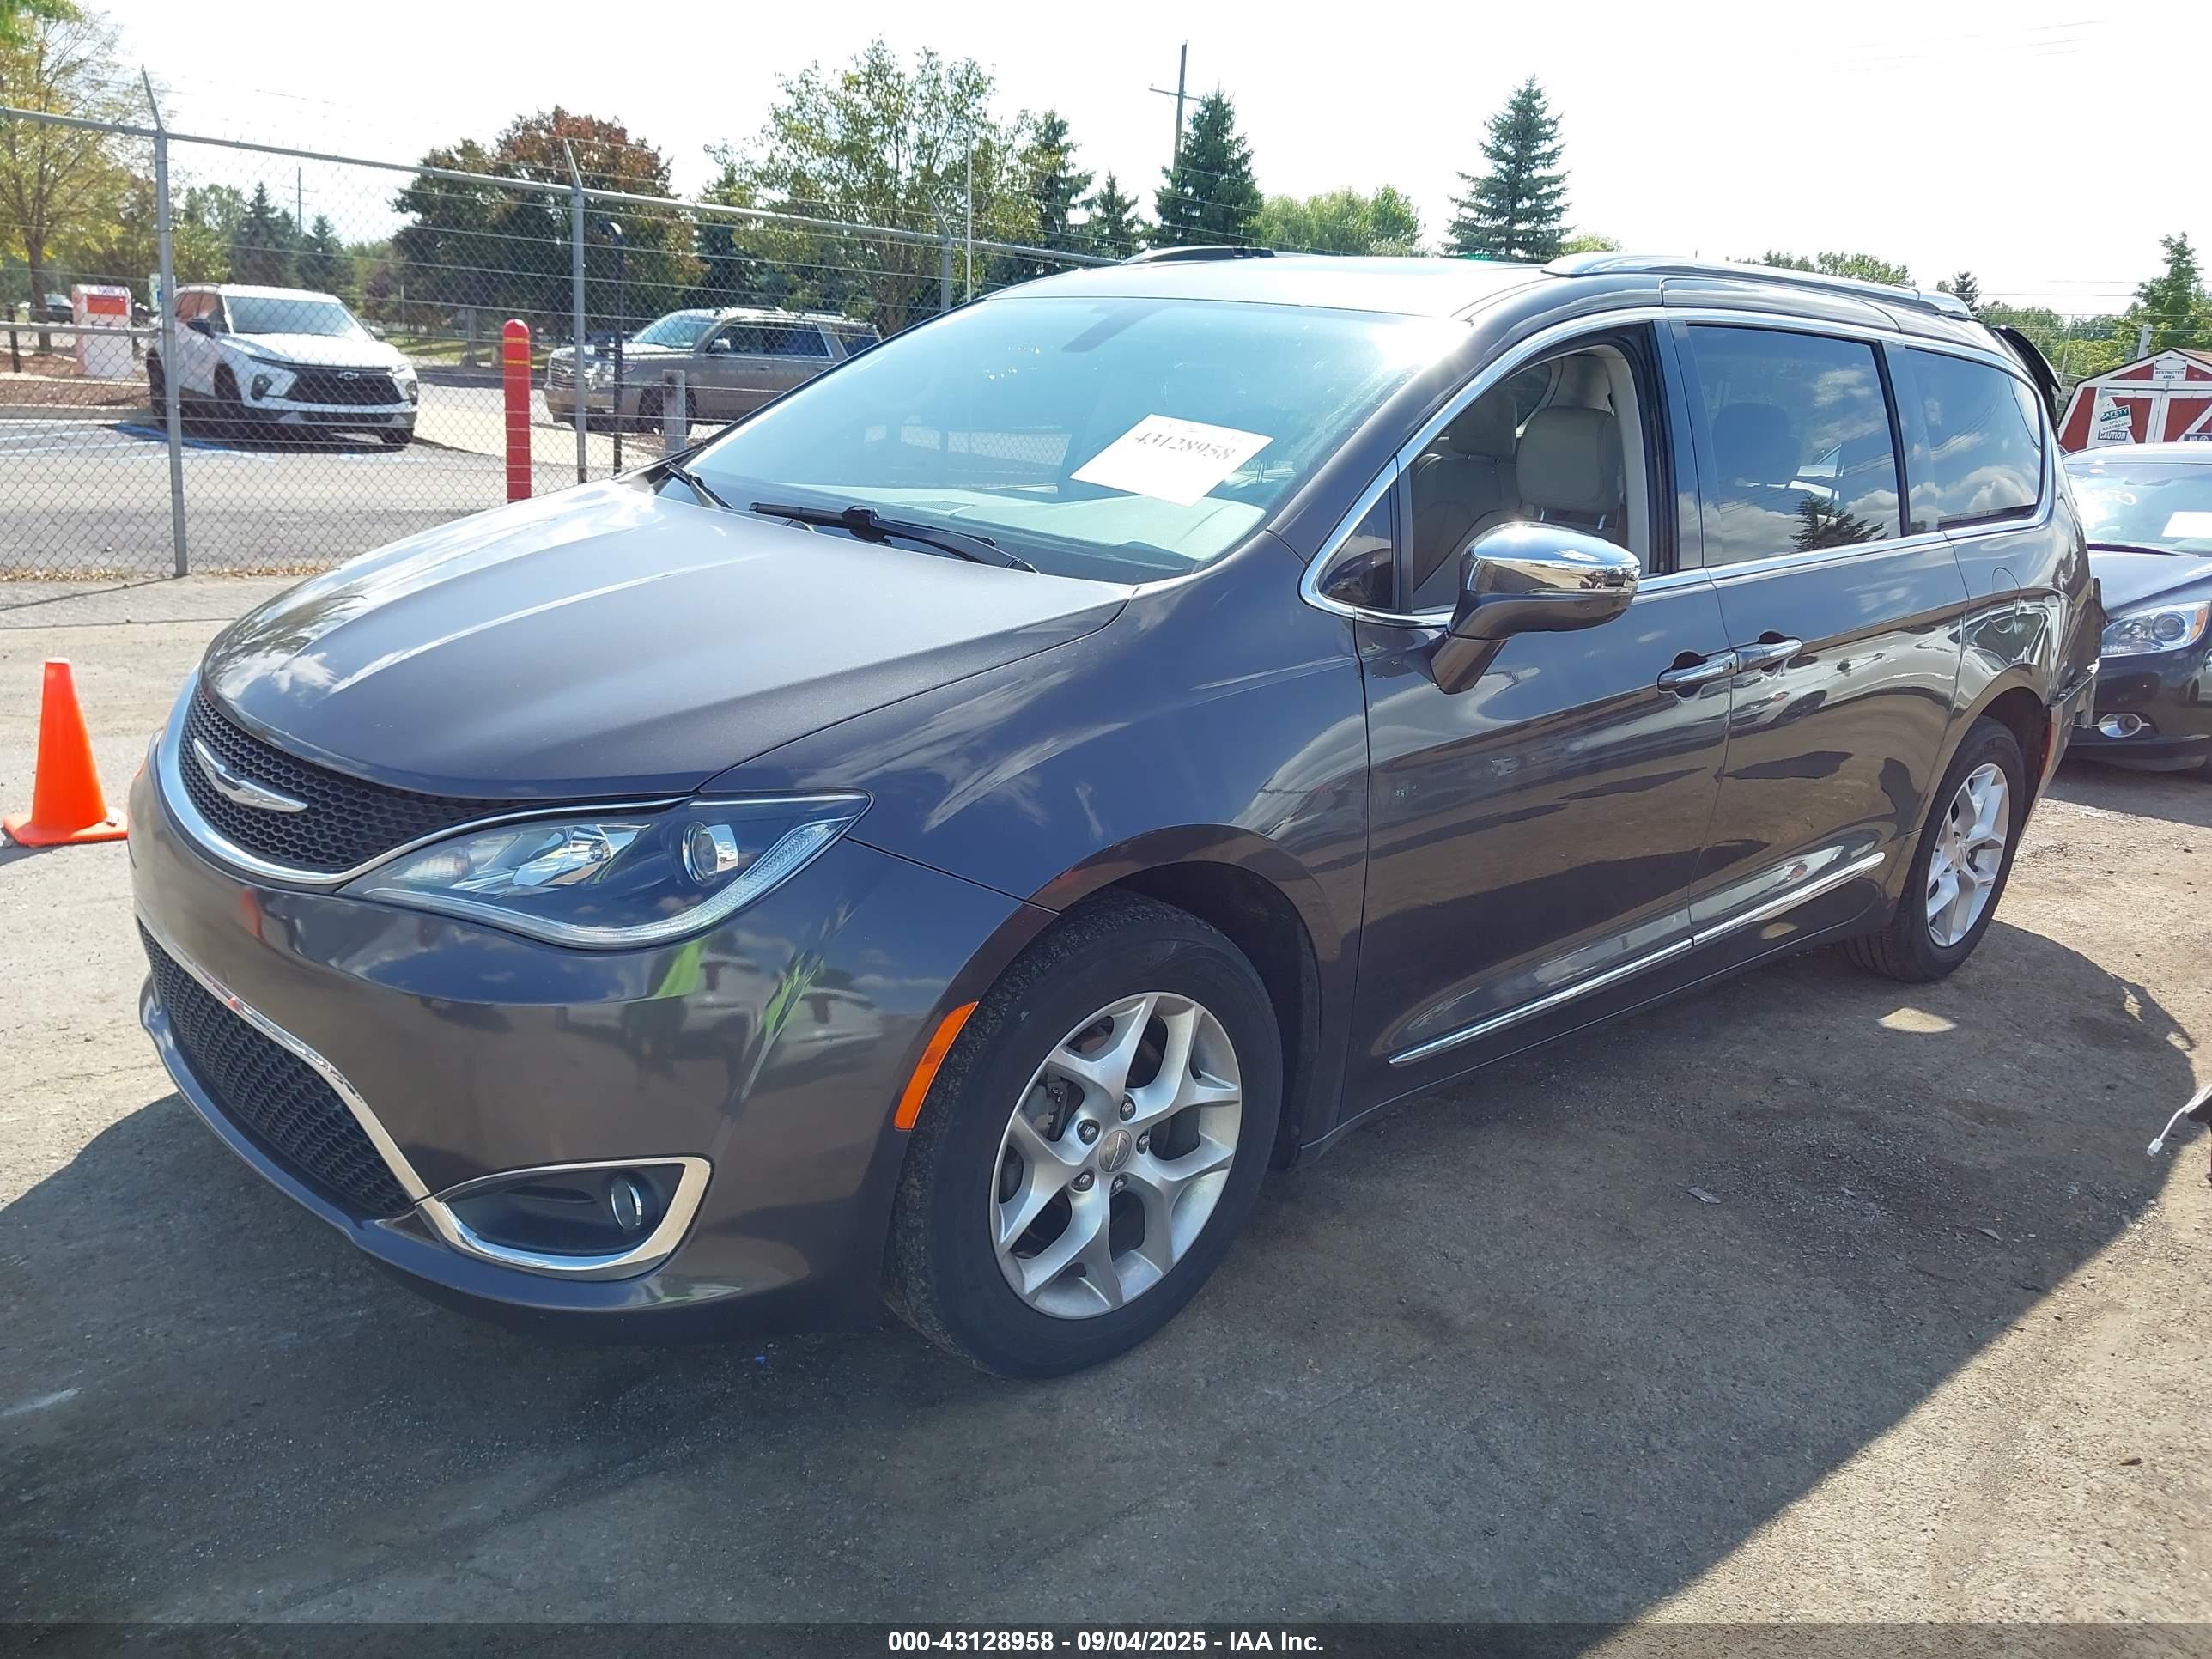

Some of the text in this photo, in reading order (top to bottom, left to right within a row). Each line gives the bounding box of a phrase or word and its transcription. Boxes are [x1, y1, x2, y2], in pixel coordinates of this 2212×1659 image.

[2100, 408, 2128, 420] SAFETY
[2100, 431, 2126, 440] CAUTION
[1135, 432, 1236, 459] 43128958
